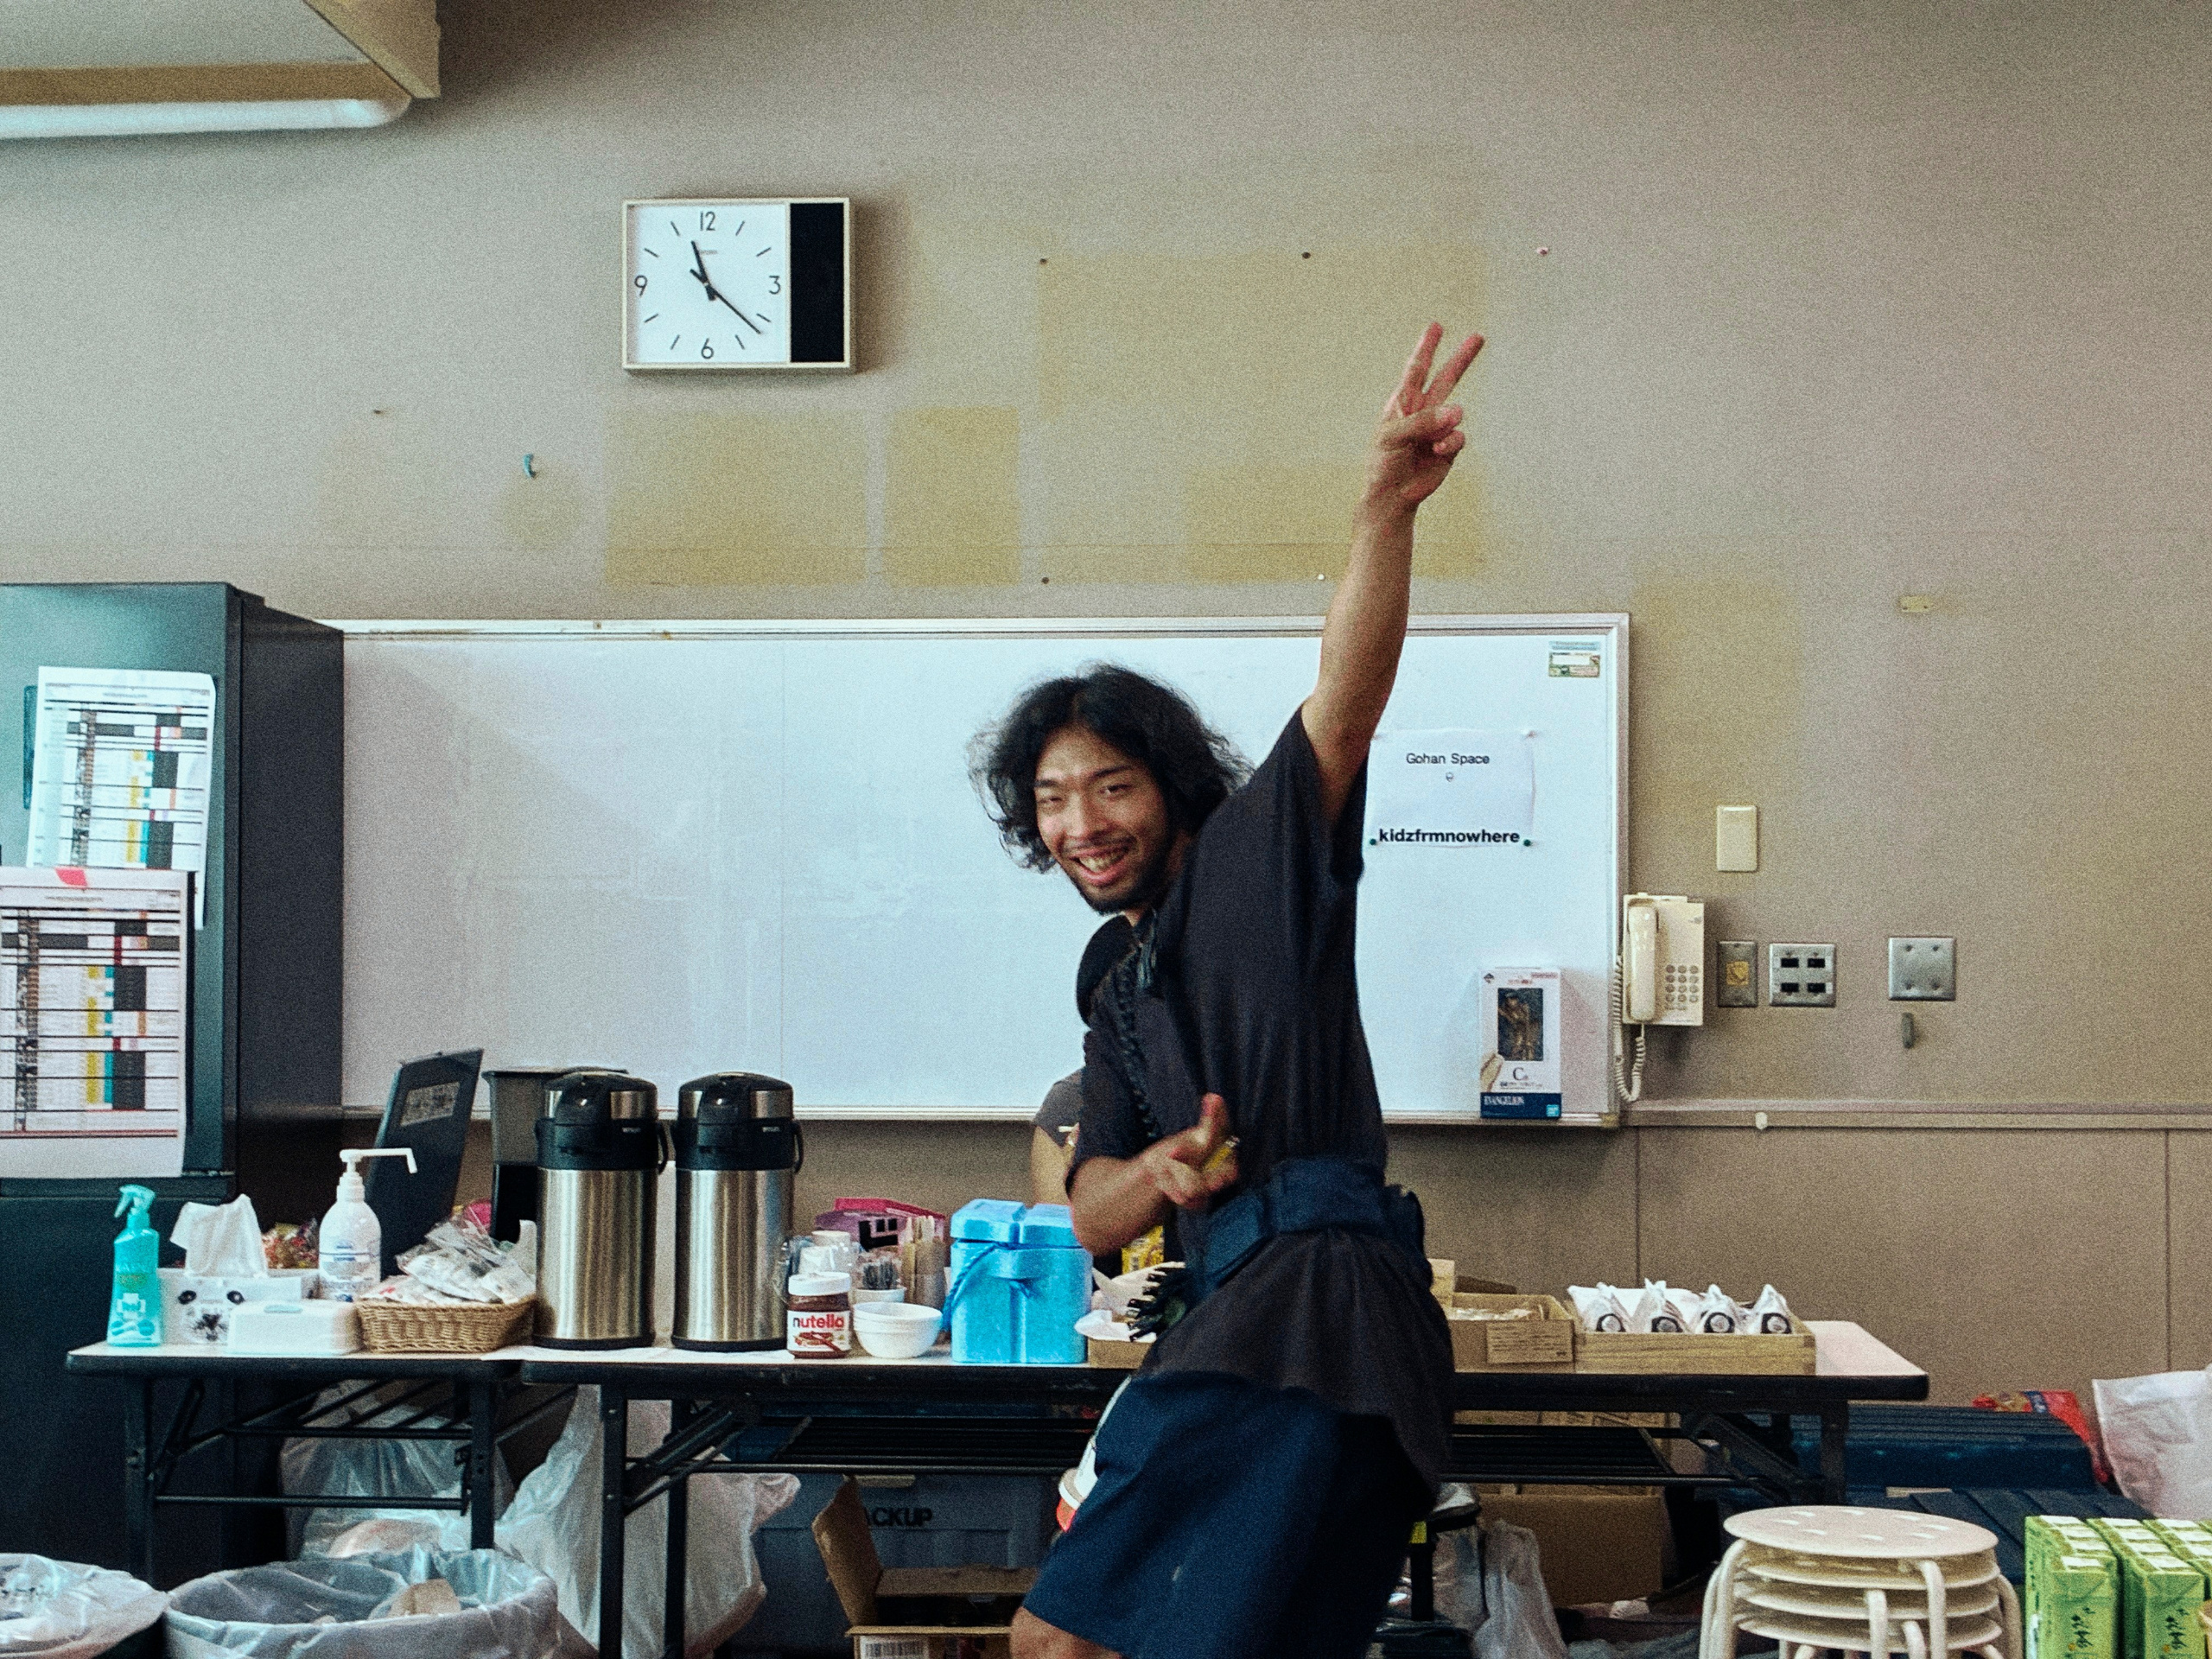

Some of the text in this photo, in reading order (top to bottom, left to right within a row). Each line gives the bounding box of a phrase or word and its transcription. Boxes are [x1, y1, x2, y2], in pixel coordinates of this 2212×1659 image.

[700, 211, 716, 232] 12
[634, 275, 781, 297] 9 3
[701, 338, 715, 359] 6
[1406, 753, 1491, 766] Gohan Space
[1379, 829, 1520, 843] kidzfrmnowhere
[792, 1313, 845, 1329] nutella
